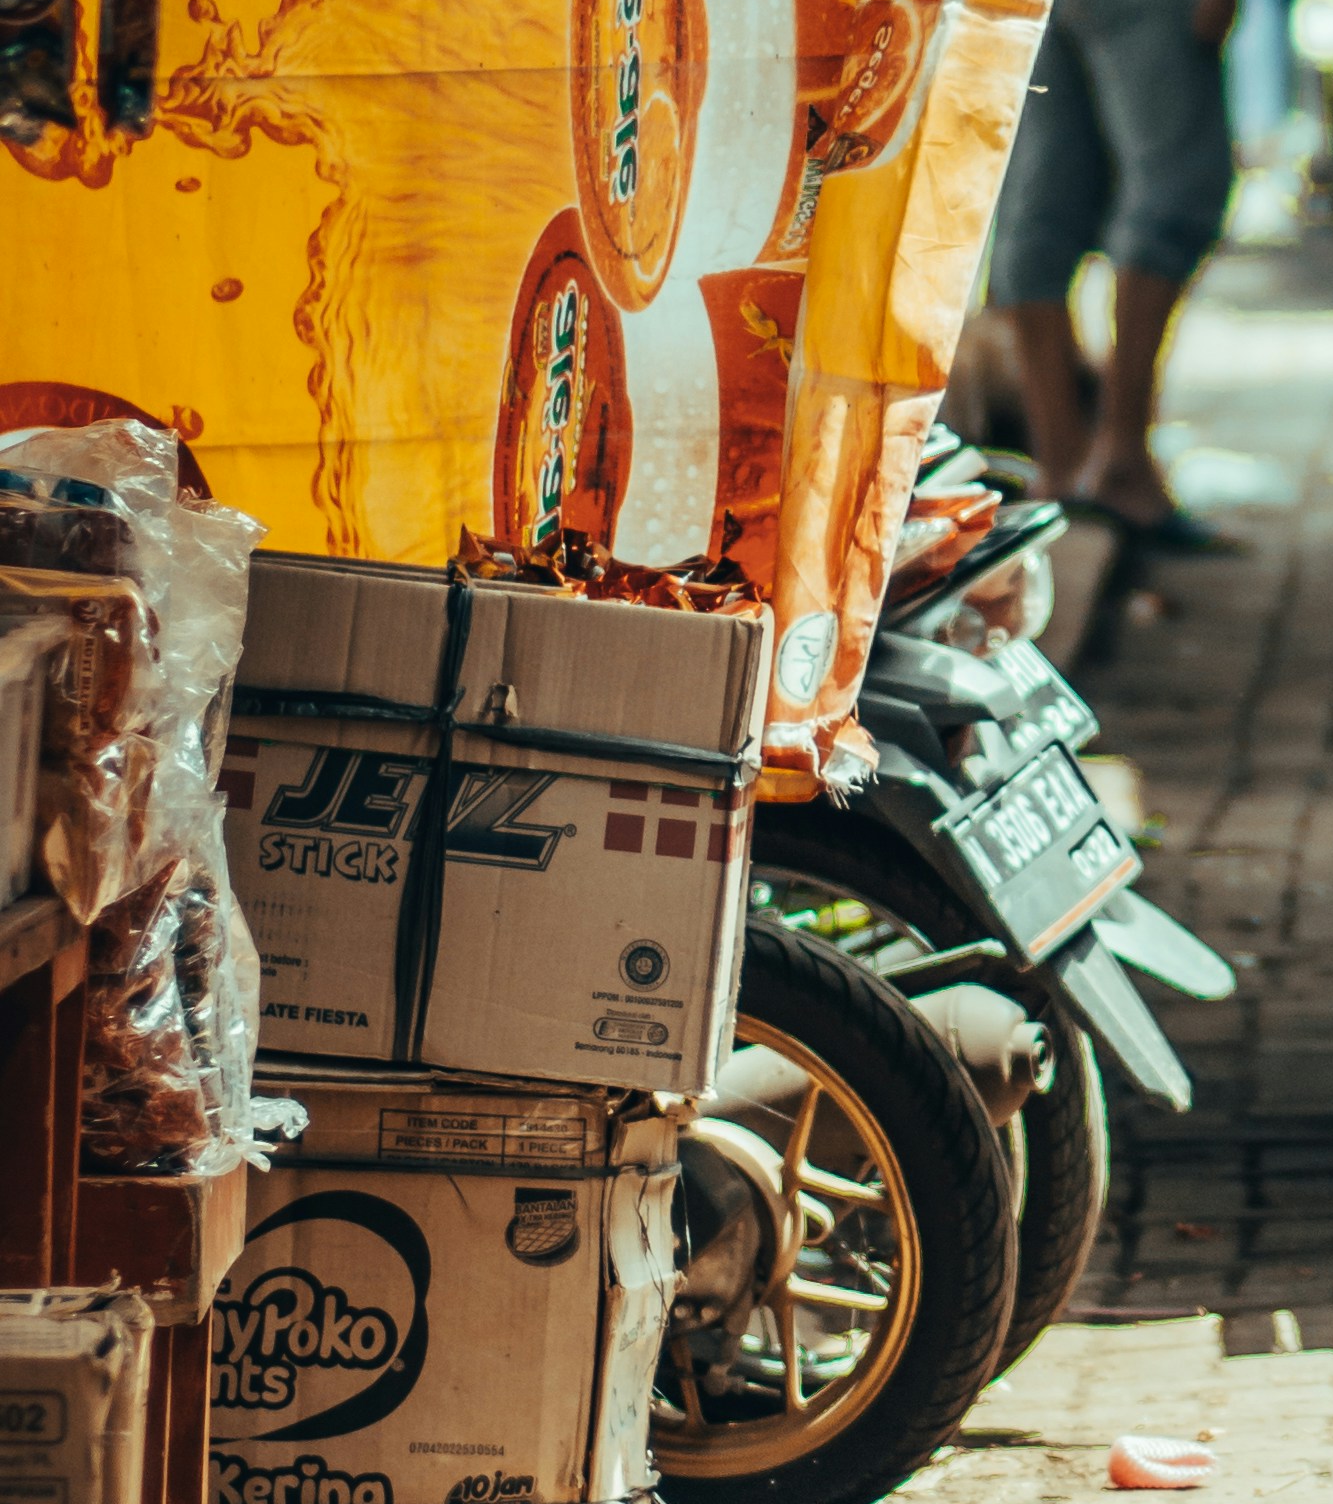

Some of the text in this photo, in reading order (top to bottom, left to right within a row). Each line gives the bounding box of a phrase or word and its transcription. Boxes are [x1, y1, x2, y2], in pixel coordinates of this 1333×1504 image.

[260, 832, 400, 884] STICK
[304, 1006, 370, 1029] FIESTA
[406, 1116, 479, 1131] ITEM CODE
[395, 1135, 441, 1148] PIECES
[452, 1138, 488, 1151] PACK
[211, 1362, 292, 1405] nts
[461, 1470, 535, 1501] 10 jam
